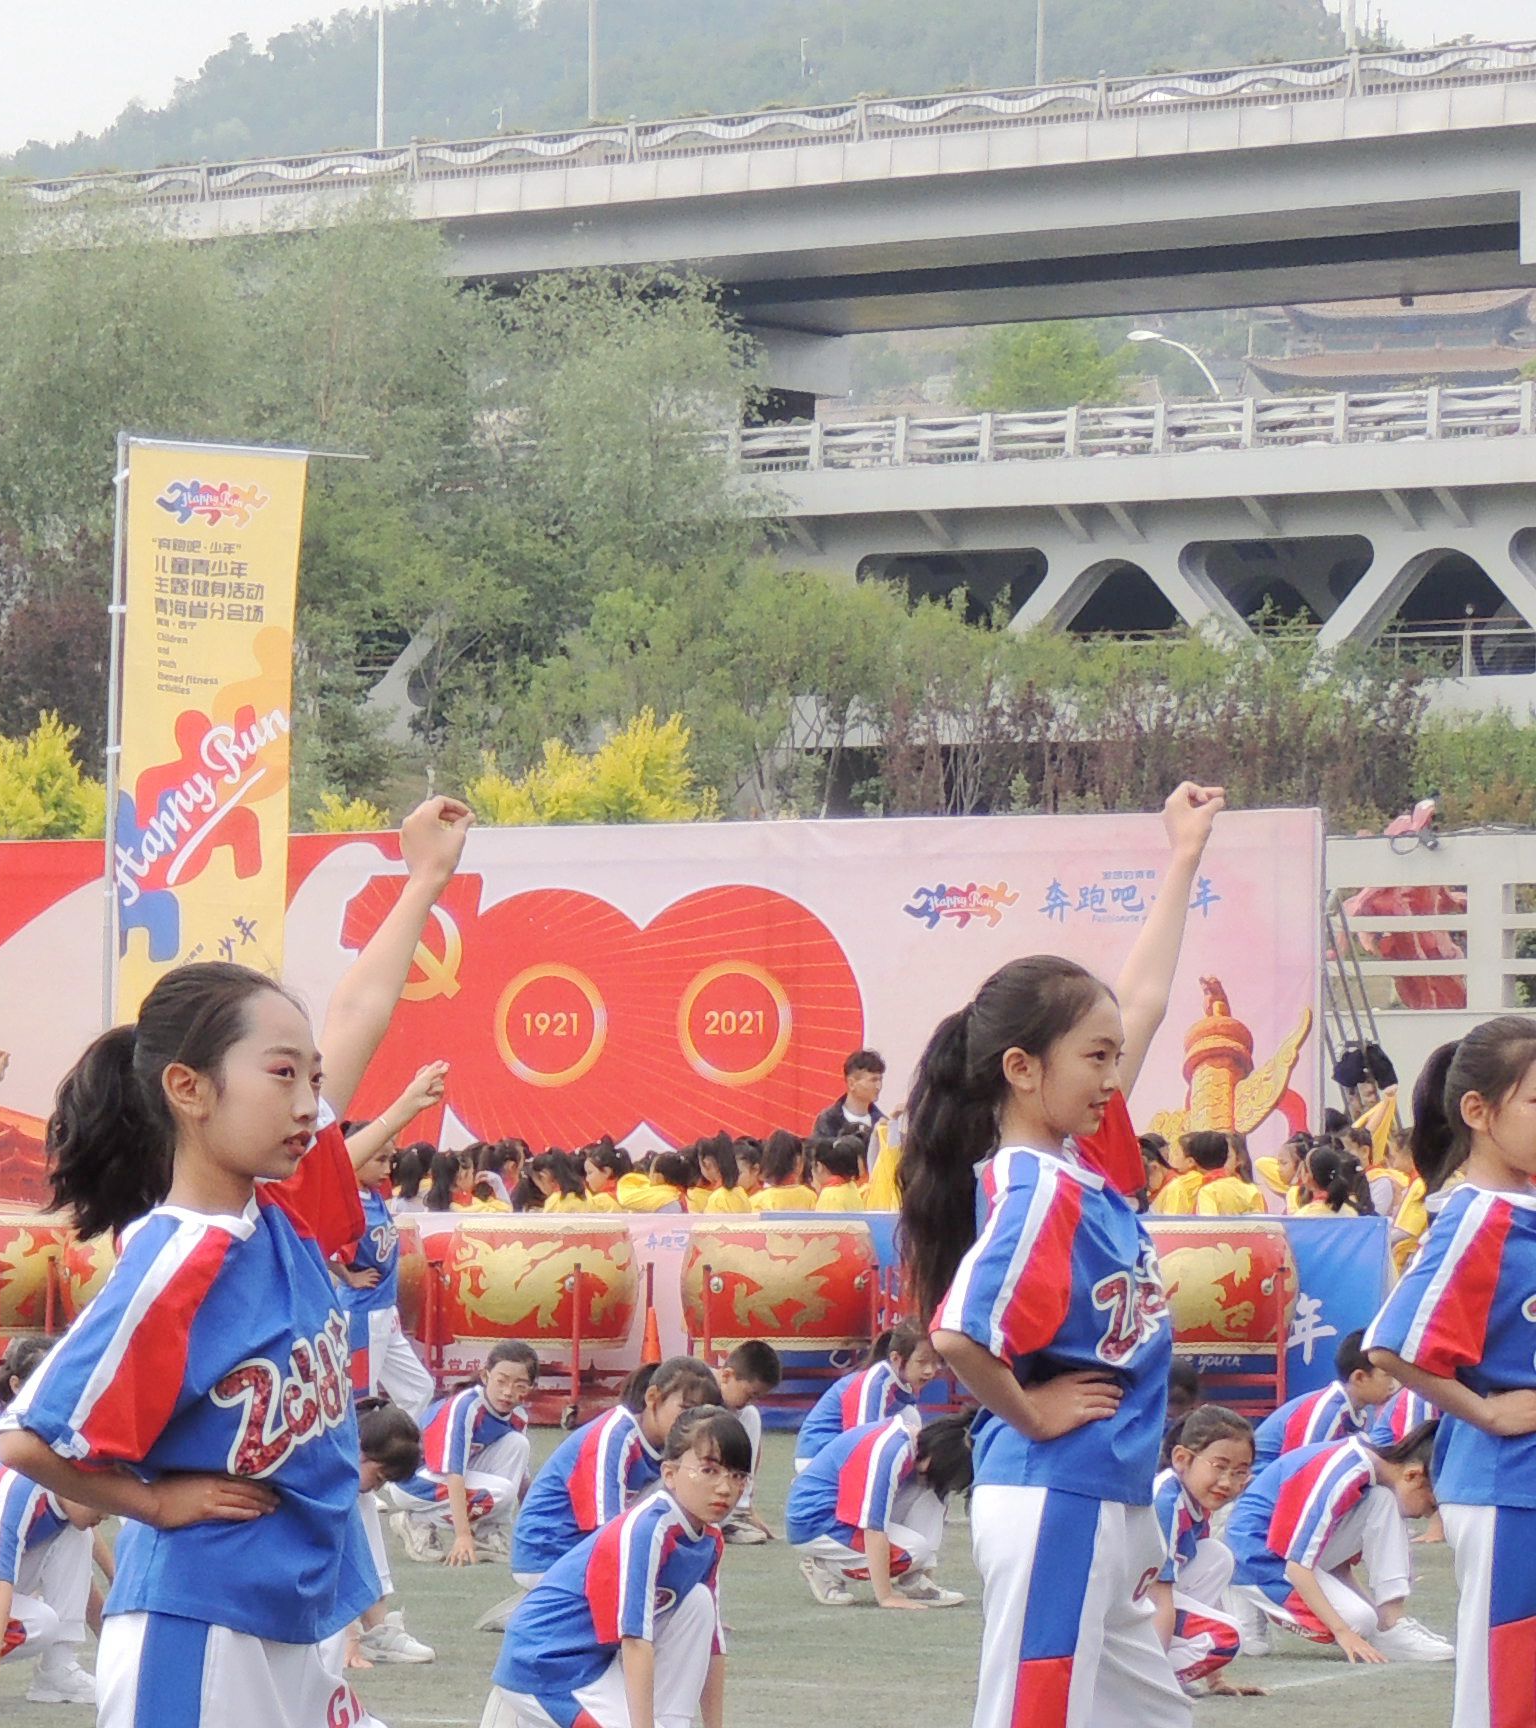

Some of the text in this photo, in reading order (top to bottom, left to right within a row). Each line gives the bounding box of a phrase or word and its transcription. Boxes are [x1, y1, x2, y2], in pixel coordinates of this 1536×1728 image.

[155, 555, 248, 578] 儿童青少年
[155, 576, 265, 600] 主题健身活动
[154, 597, 264, 623] 青海省分会场
[115, 708, 291, 907] Happy Run
[1038, 876, 1222, 923] 奔跑吧·年
[522, 1012, 579, 1036] 1921
[704, 1010, 765, 1035] 2021
